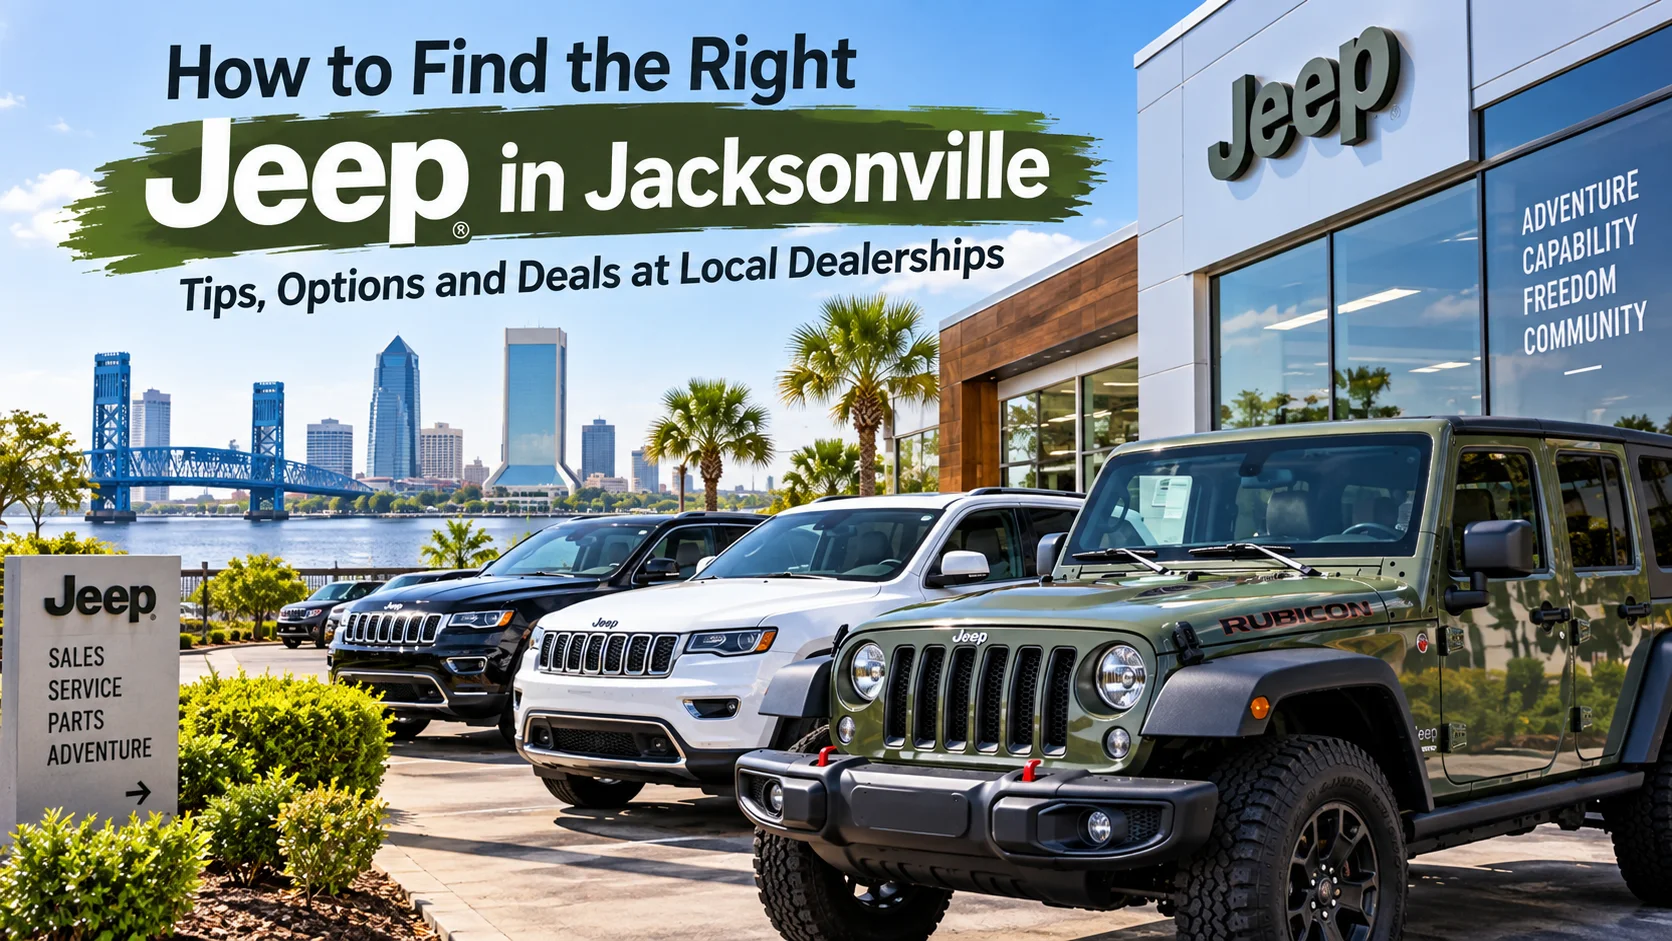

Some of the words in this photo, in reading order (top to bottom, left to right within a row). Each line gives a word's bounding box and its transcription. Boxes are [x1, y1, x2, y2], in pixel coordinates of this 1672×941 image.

[1521, 168, 1640, 236] ADVENTURE
[1522, 213, 1639, 275] CAPABILITY
[1523, 263, 1617, 316] FREEDOM
[1523, 300, 1648, 356] COMMUNITY
[1218, 600, 1374, 636] RUBICON
[952, 628, 988, 646] Jeep
[48, 645, 105, 669] SALES
[48, 676, 123, 701] SERVICE
[48, 709, 105, 734] PARTS
[1415, 725, 1438, 743] eep
[47, 737, 152, 767] ADVENTURE
